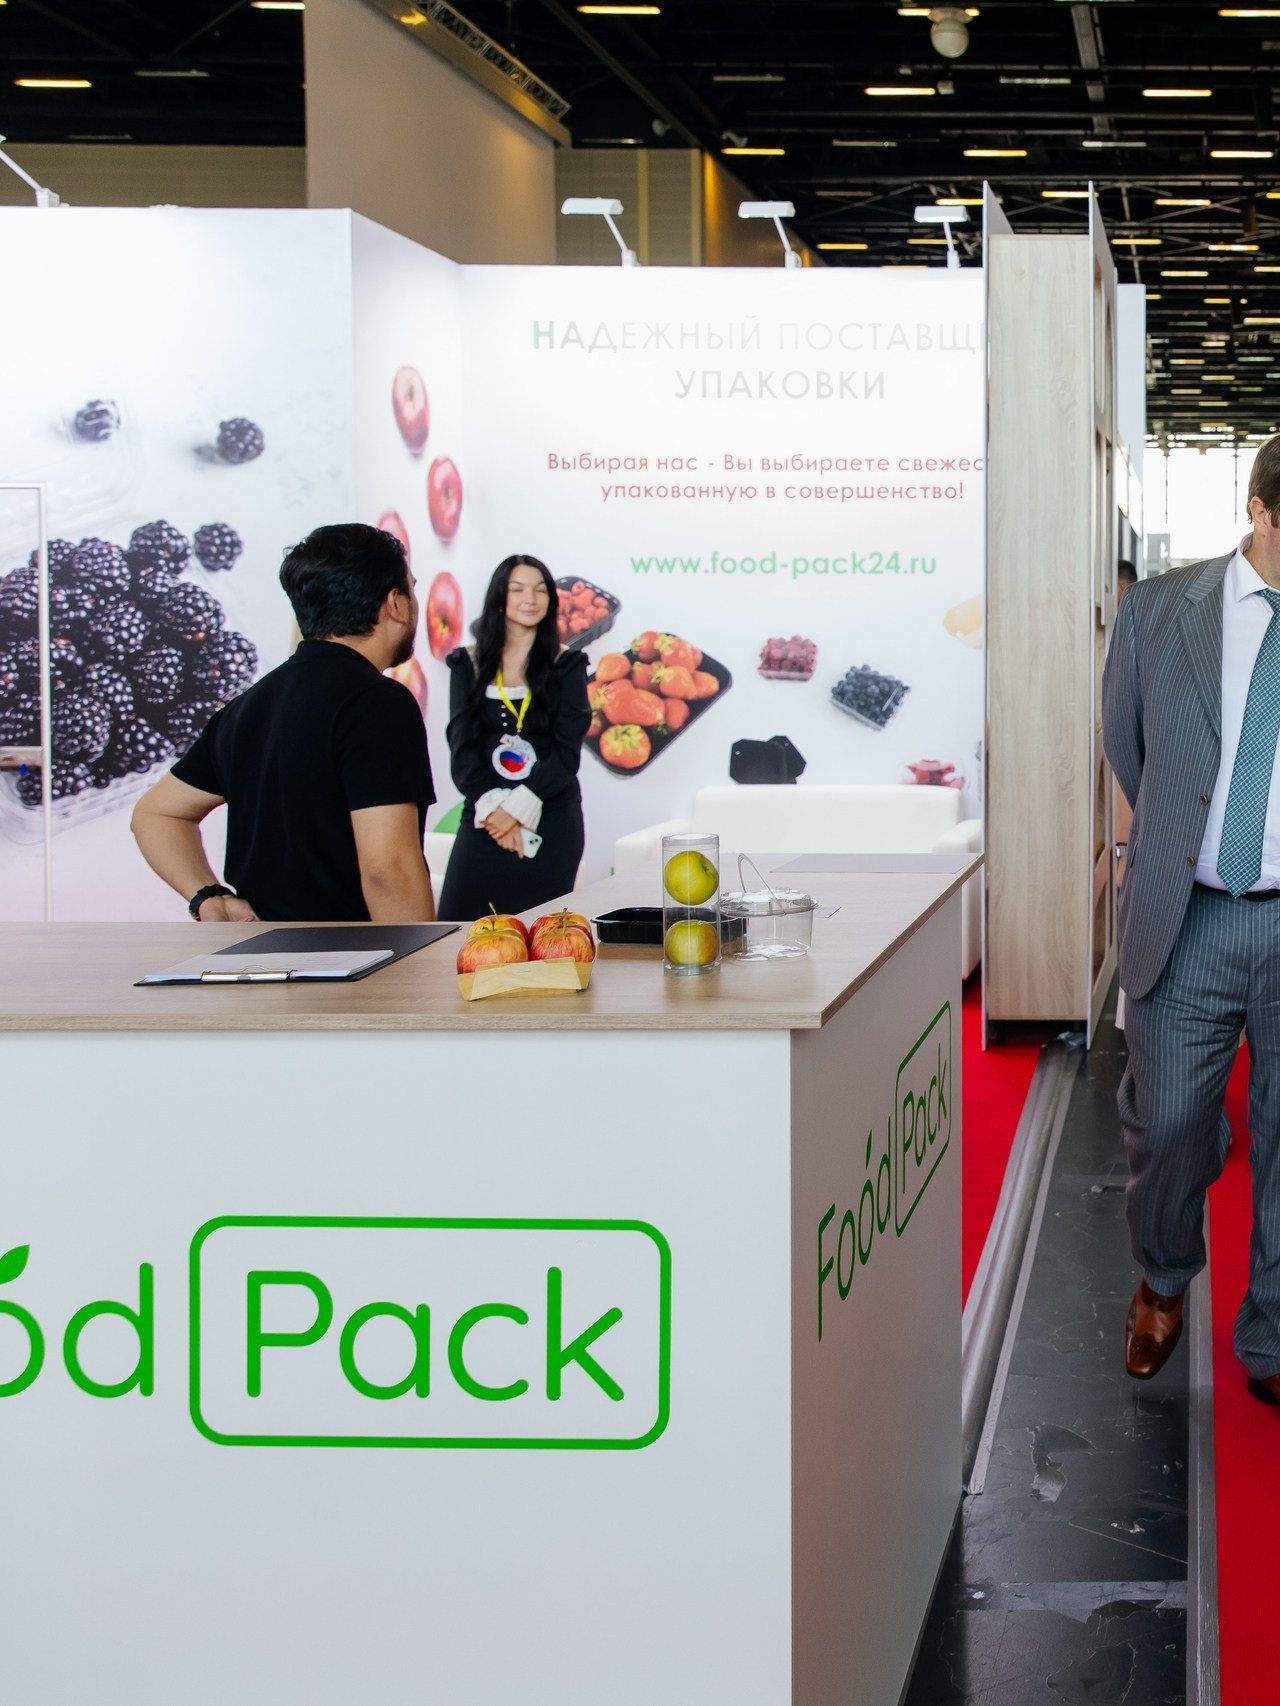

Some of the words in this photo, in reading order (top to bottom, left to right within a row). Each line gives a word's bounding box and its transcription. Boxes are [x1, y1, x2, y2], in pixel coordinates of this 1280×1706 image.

[532, 315, 761, 354] НАДЕЖНЫЙ
[780, 321, 985, 355] ПОСТАВЩ
[674, 370, 886, 399] УПАКОВКИ
[548, 452, 648, 474] Выбирая
[657, 457, 698, 471] нас
[724, 454, 752, 471] Вы
[761, 453, 889, 475] выбираете
[897, 455, 988, 472] свежес
[601, 484, 757, 503] упакованную
[766, 486, 776, 499] в
[784, 482, 964, 503] совершенство!
[629, 551, 937, 580] www.food-pack24.ru
[902, 1043, 948, 1194] Pack
[247, 1266, 625, 1402] Pack
